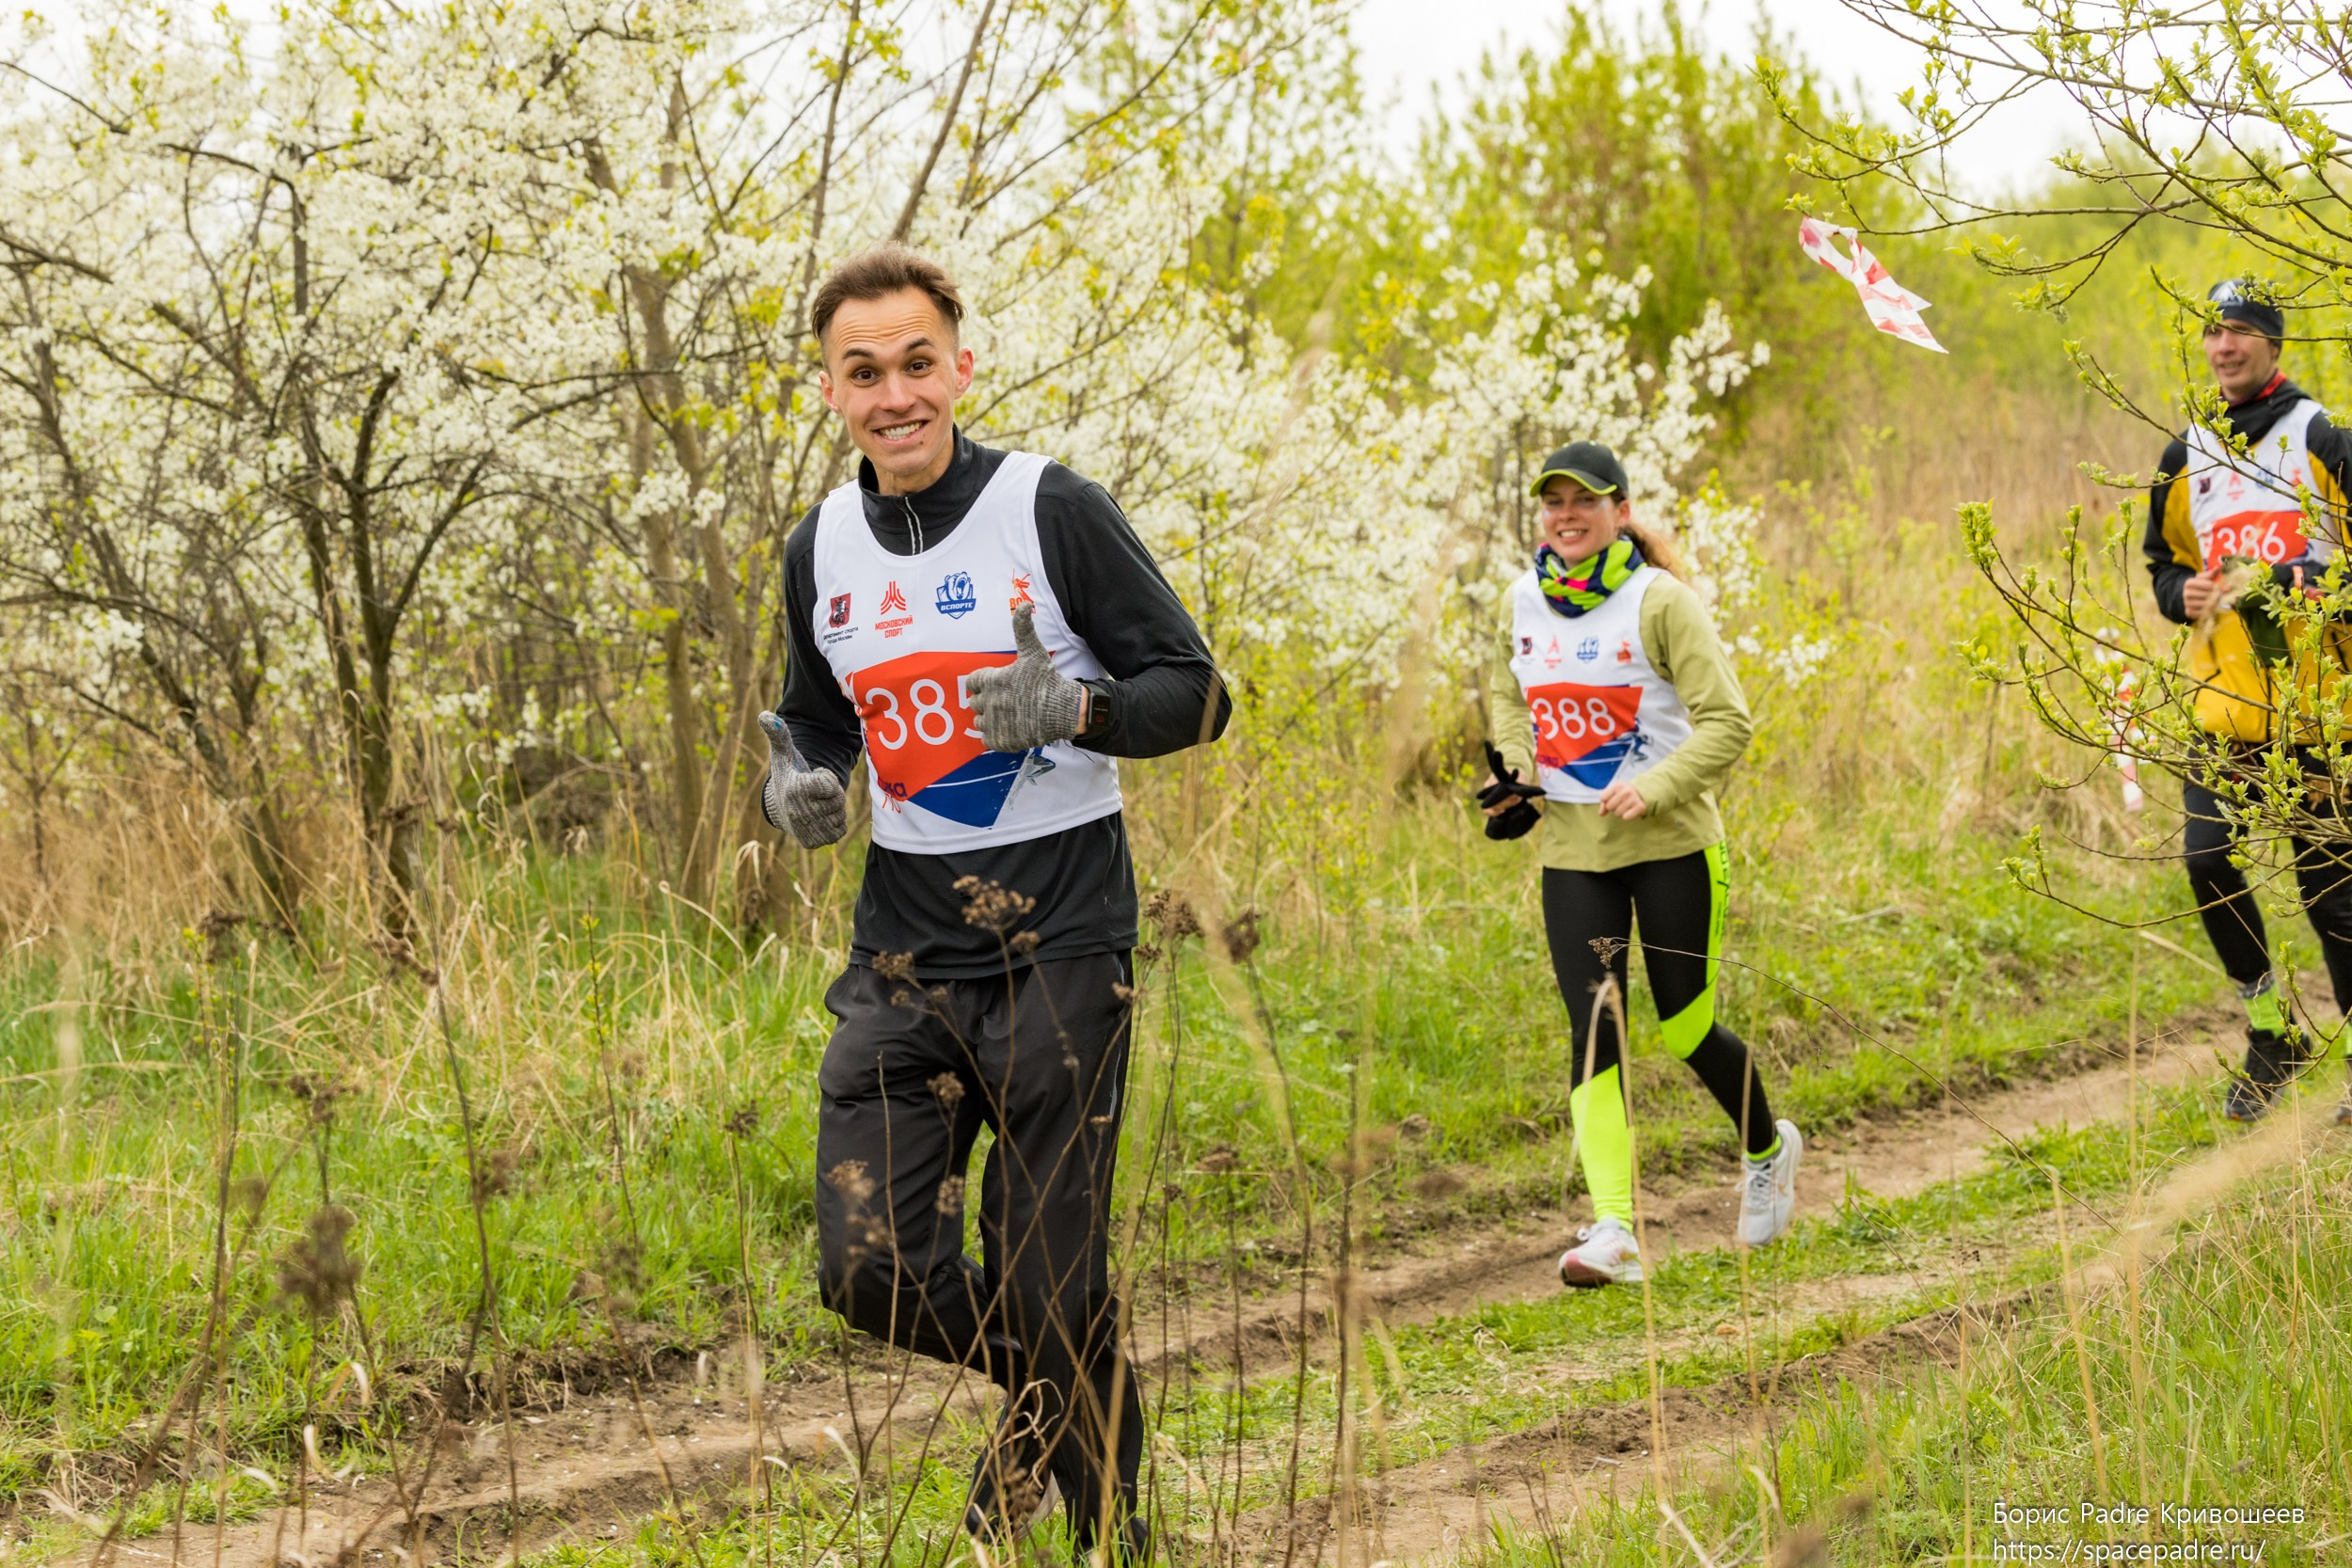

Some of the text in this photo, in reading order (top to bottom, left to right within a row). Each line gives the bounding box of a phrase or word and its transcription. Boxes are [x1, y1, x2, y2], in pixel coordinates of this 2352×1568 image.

[2217, 521, 2286, 565] 386
[941, 602, 973, 611] ВСПОРТЕ
[875, 615, 914, 631] МОСКОВСКИЙ
[884, 627, 903, 639] СПОРТ
[1532, 697, 1616, 740] 388
